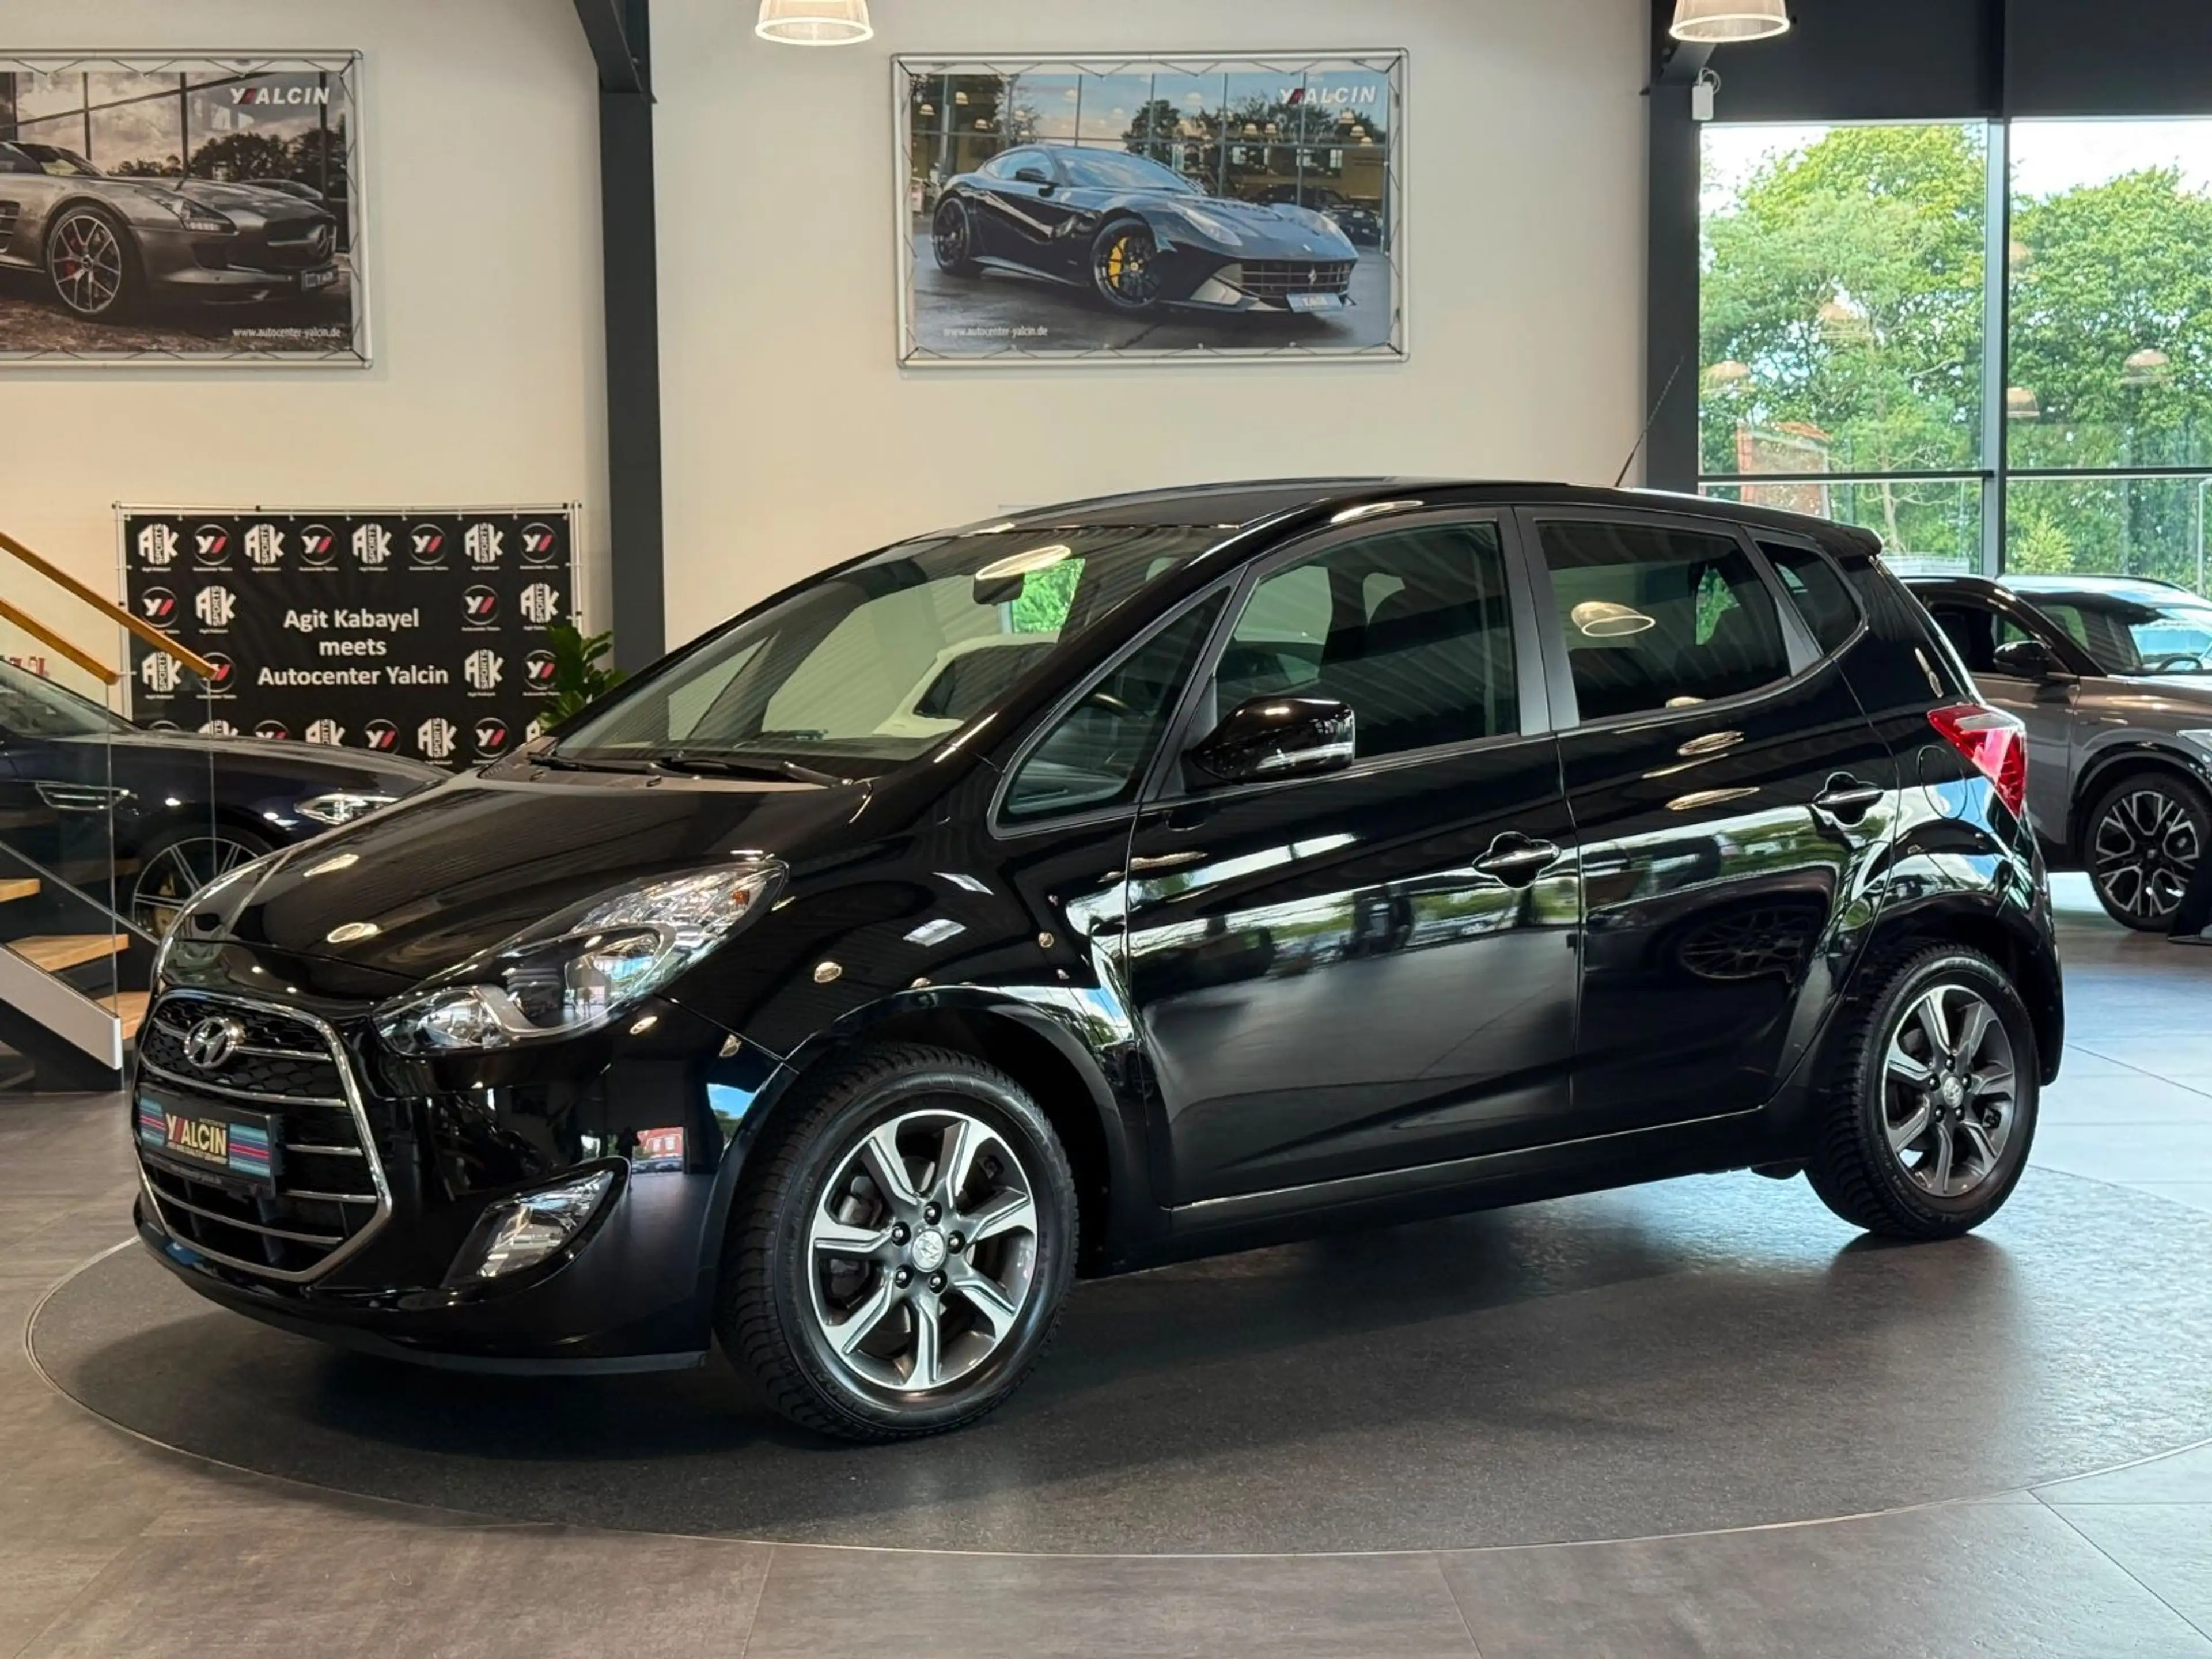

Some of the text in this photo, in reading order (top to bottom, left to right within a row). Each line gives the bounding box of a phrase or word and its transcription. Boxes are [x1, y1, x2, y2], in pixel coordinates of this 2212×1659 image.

[230, 87, 330, 104] YALCIN
[1279, 85, 1376, 104] YALCIN
[283, 608, 419, 632] Agit Kabayel
[319, 638, 387, 656] meets
[257, 665, 449, 685] Autocenter Yalcin
[165, 1113, 227, 1156] YALCIN
